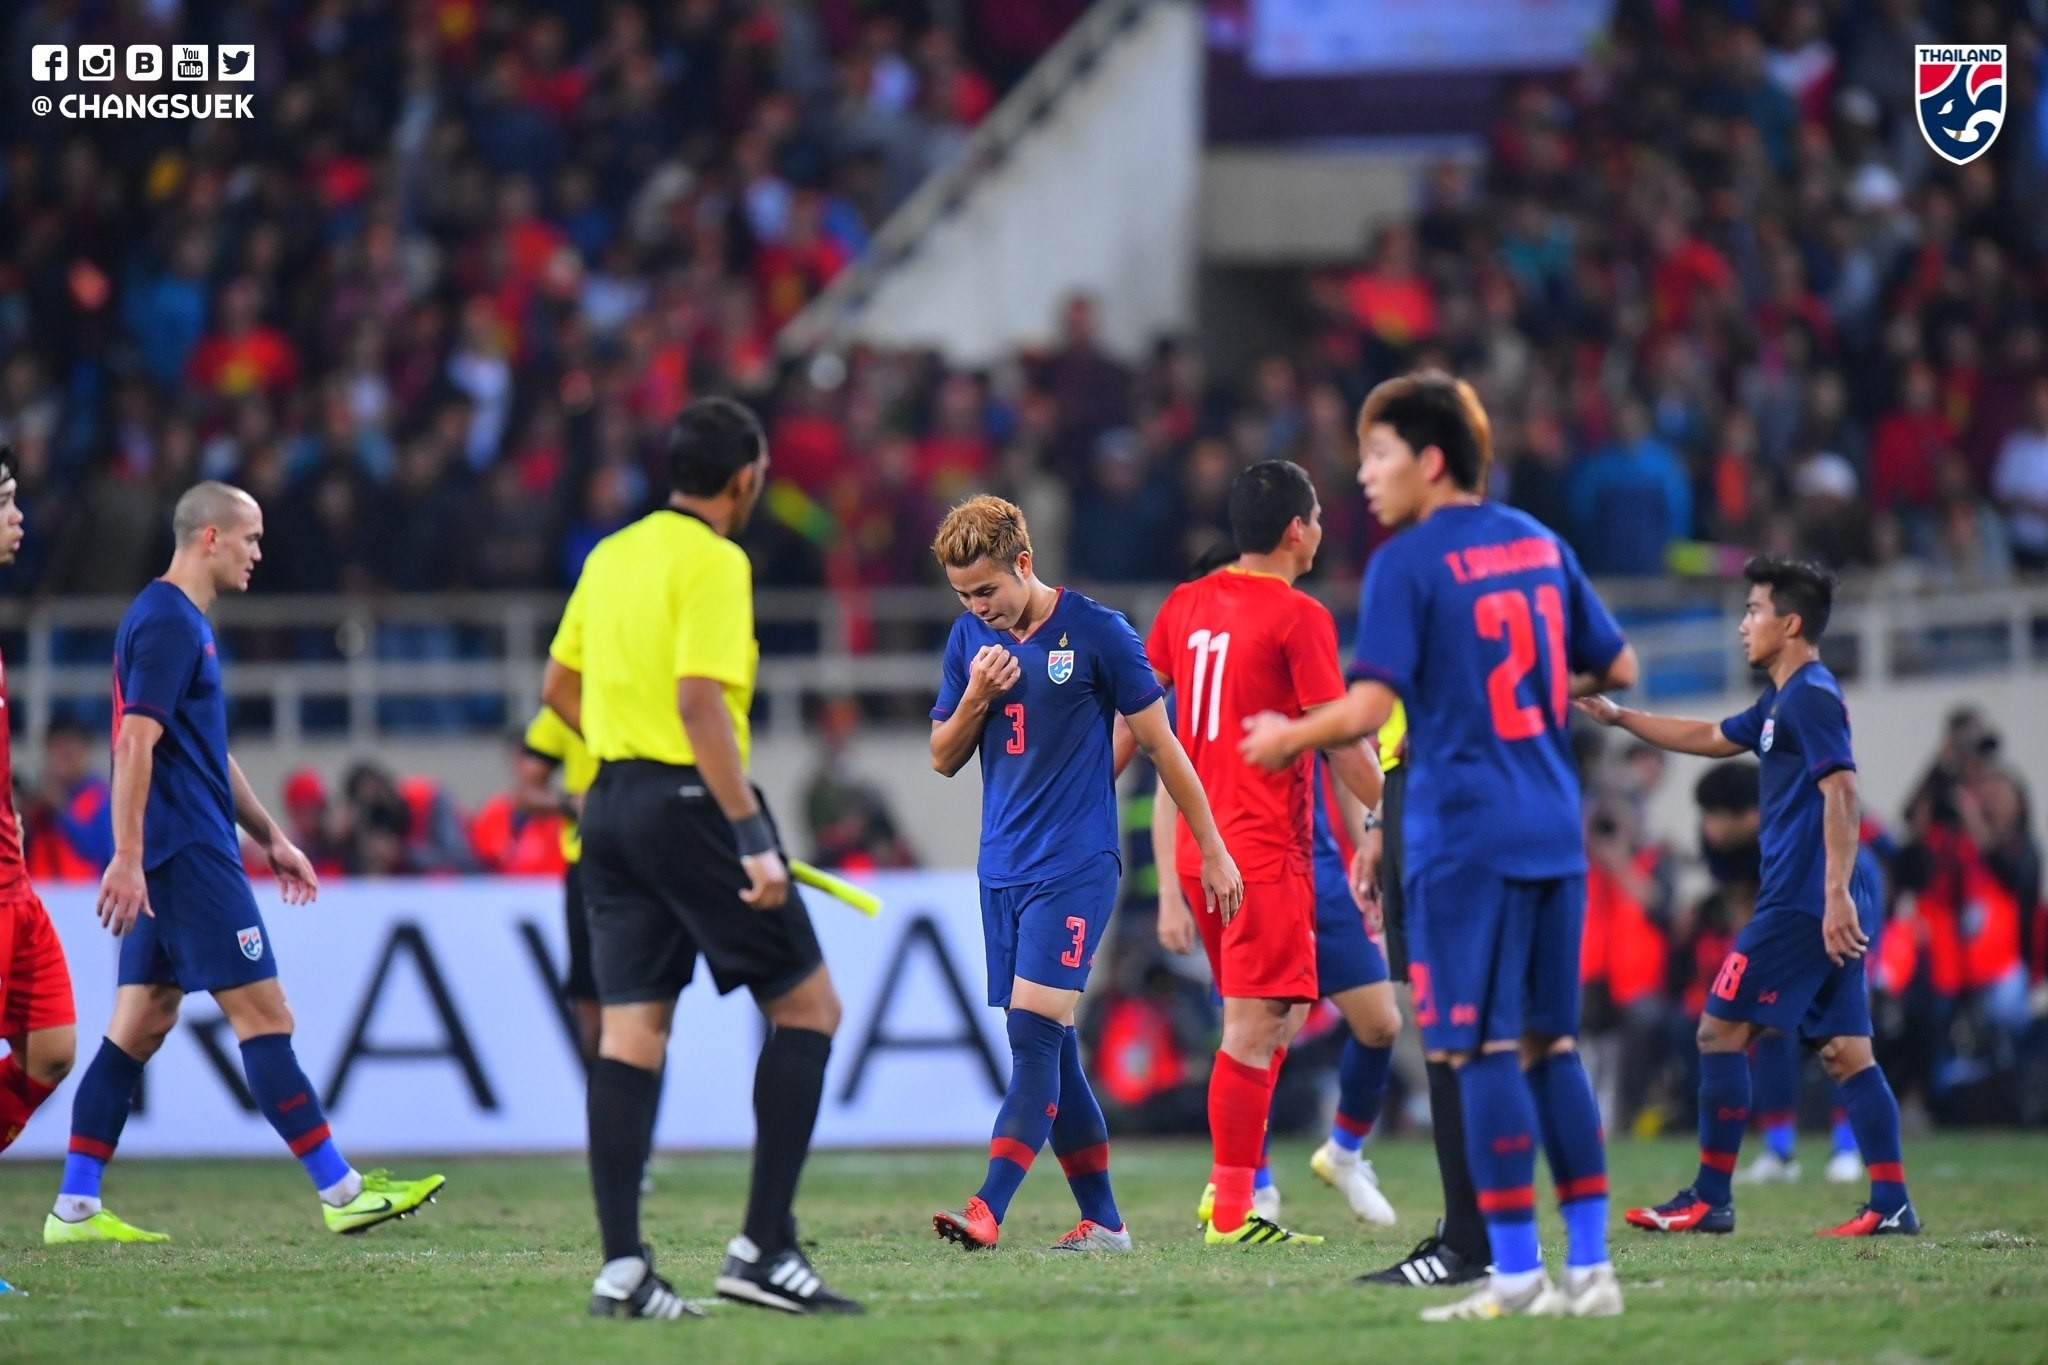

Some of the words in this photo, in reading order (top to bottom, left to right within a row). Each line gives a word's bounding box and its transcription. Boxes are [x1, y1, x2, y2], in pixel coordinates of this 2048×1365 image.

[1187, 628, 1230, 742] 11
[1474, 584, 1569, 741] 21
[1005, 703, 1025, 755] 3
[1061, 915, 1086, 968] 3
[1711, 951, 1748, 1002] 18
